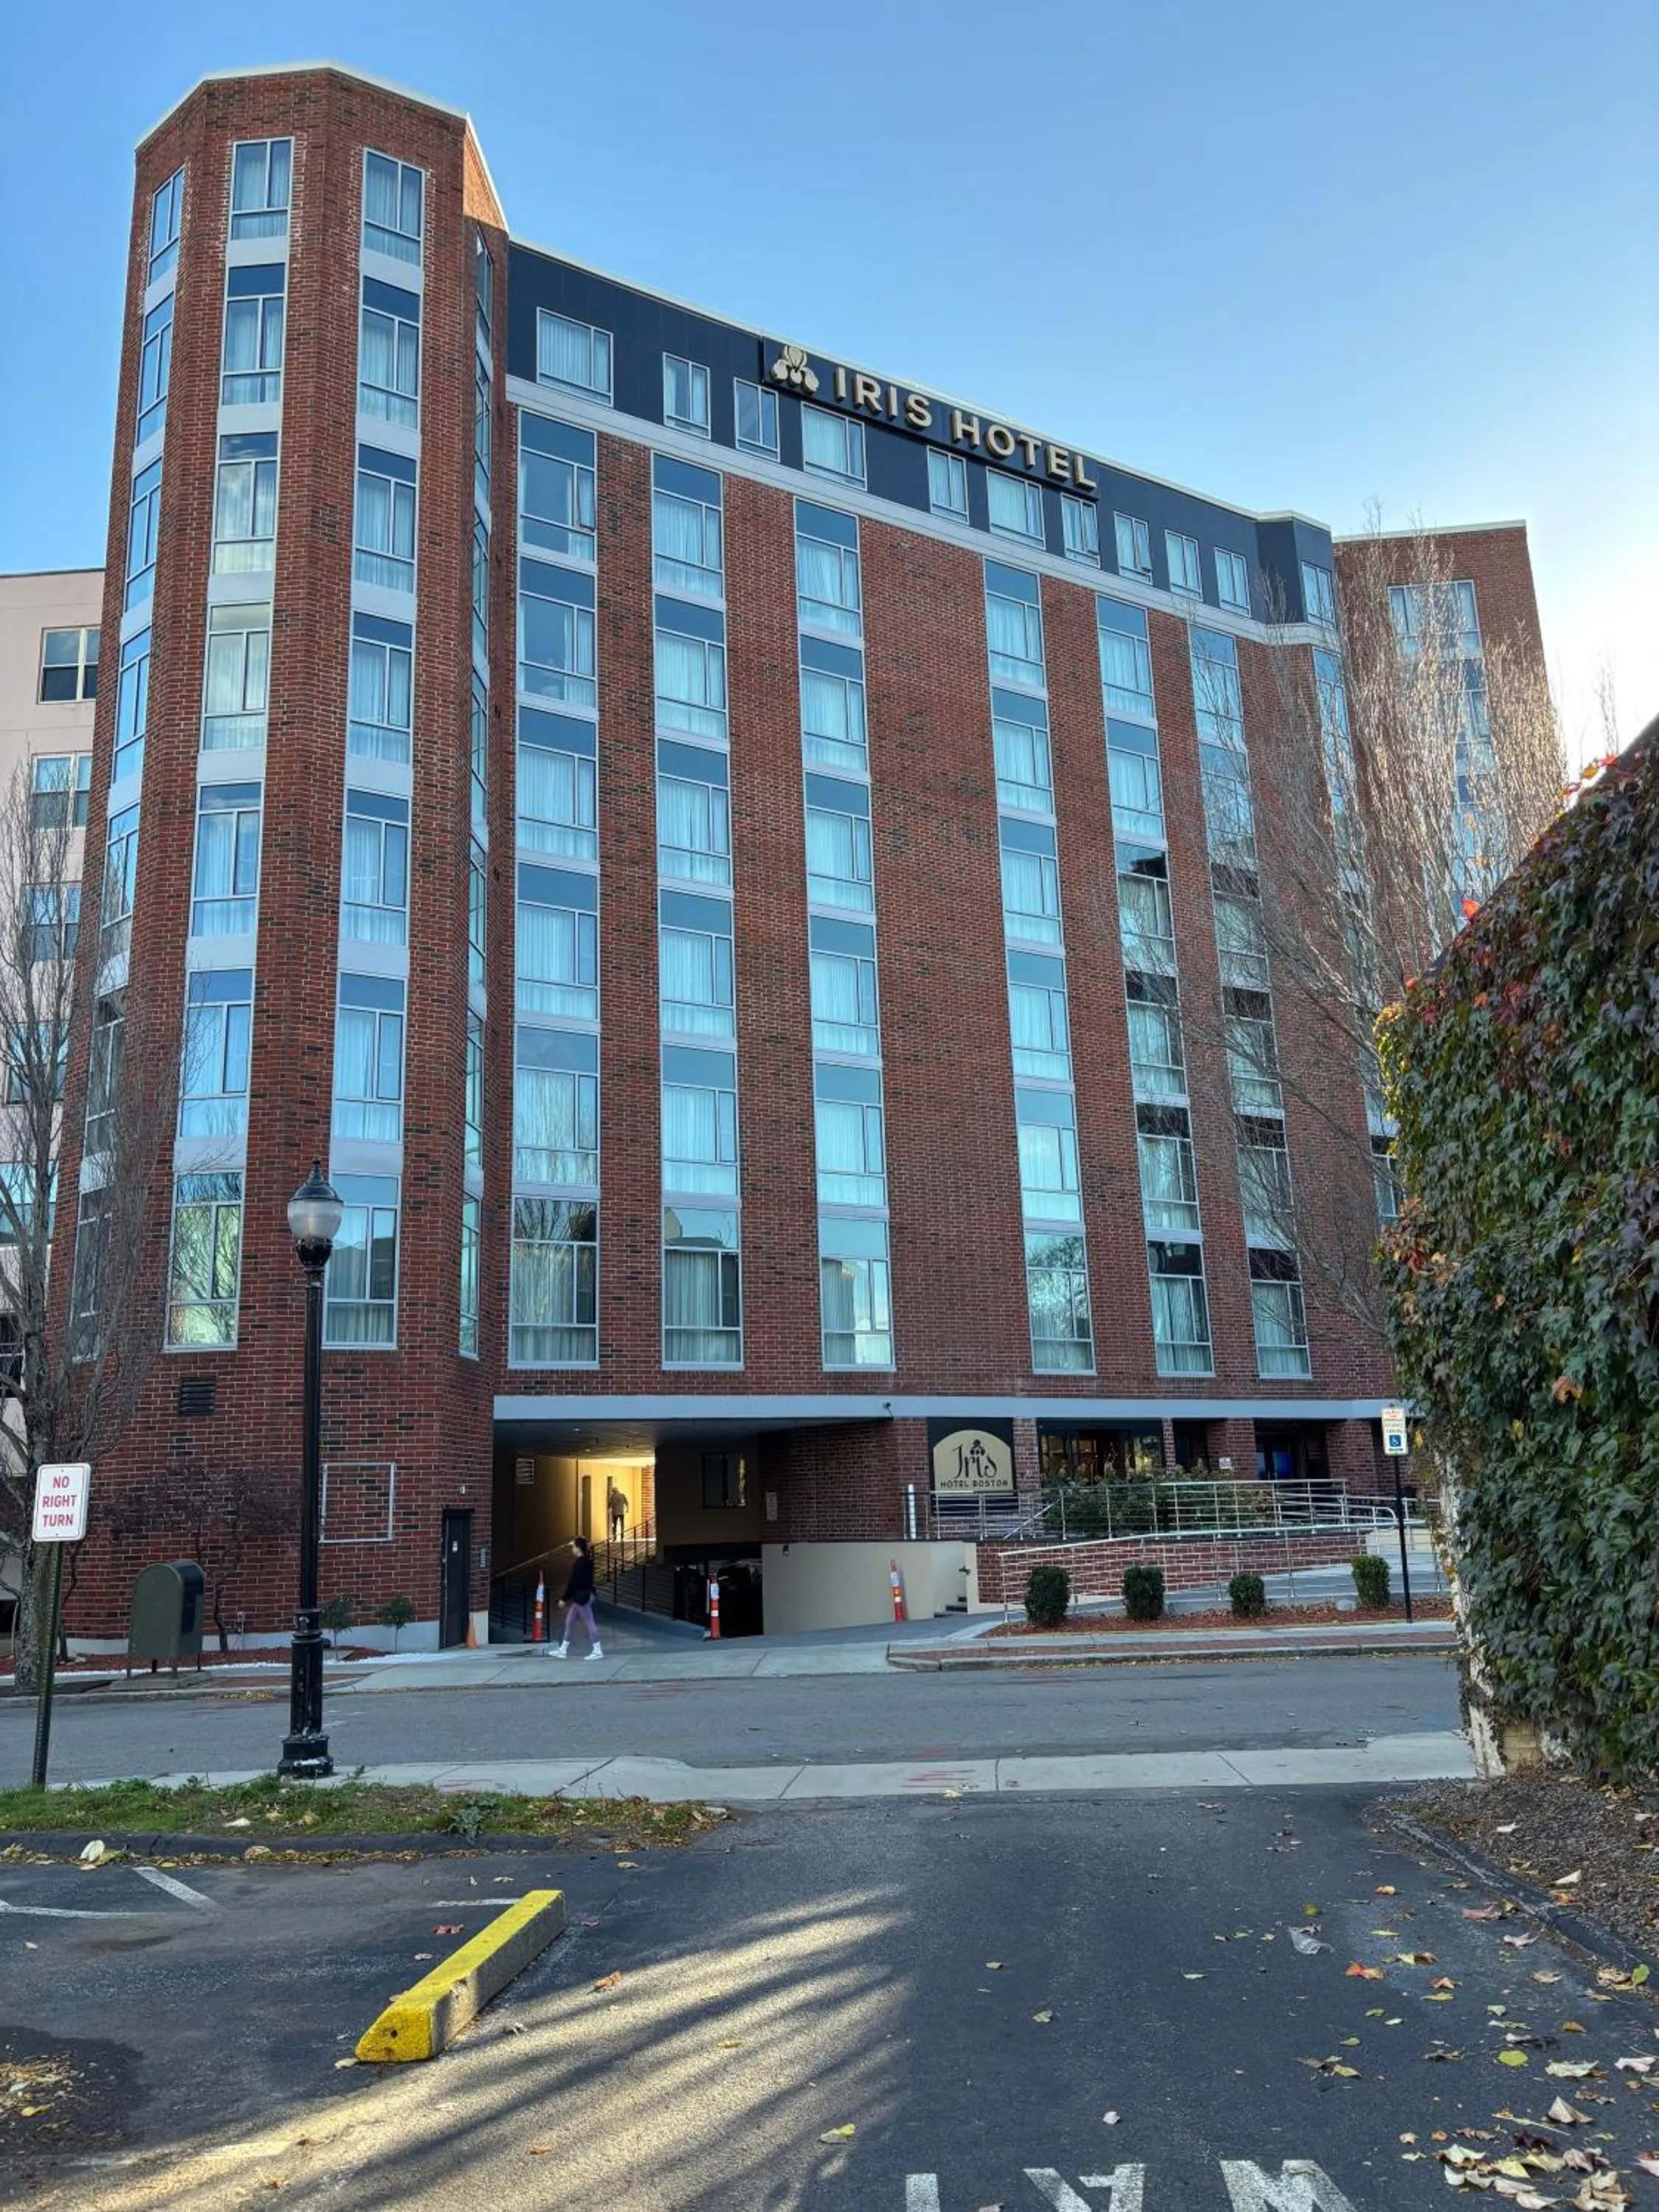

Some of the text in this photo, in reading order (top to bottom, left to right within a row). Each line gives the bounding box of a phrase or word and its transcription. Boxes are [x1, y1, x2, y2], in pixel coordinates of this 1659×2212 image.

[835, 366, 1097, 490] IRIS HOTEL
[951, 1439, 998, 1479] Iris
[52, 1475, 70, 1489] NO
[940, 1479, 1008, 1488] HOTEL BOSTON
[42, 1495, 77, 1508] RIGHT
[42, 1514, 74, 1527] TURN
